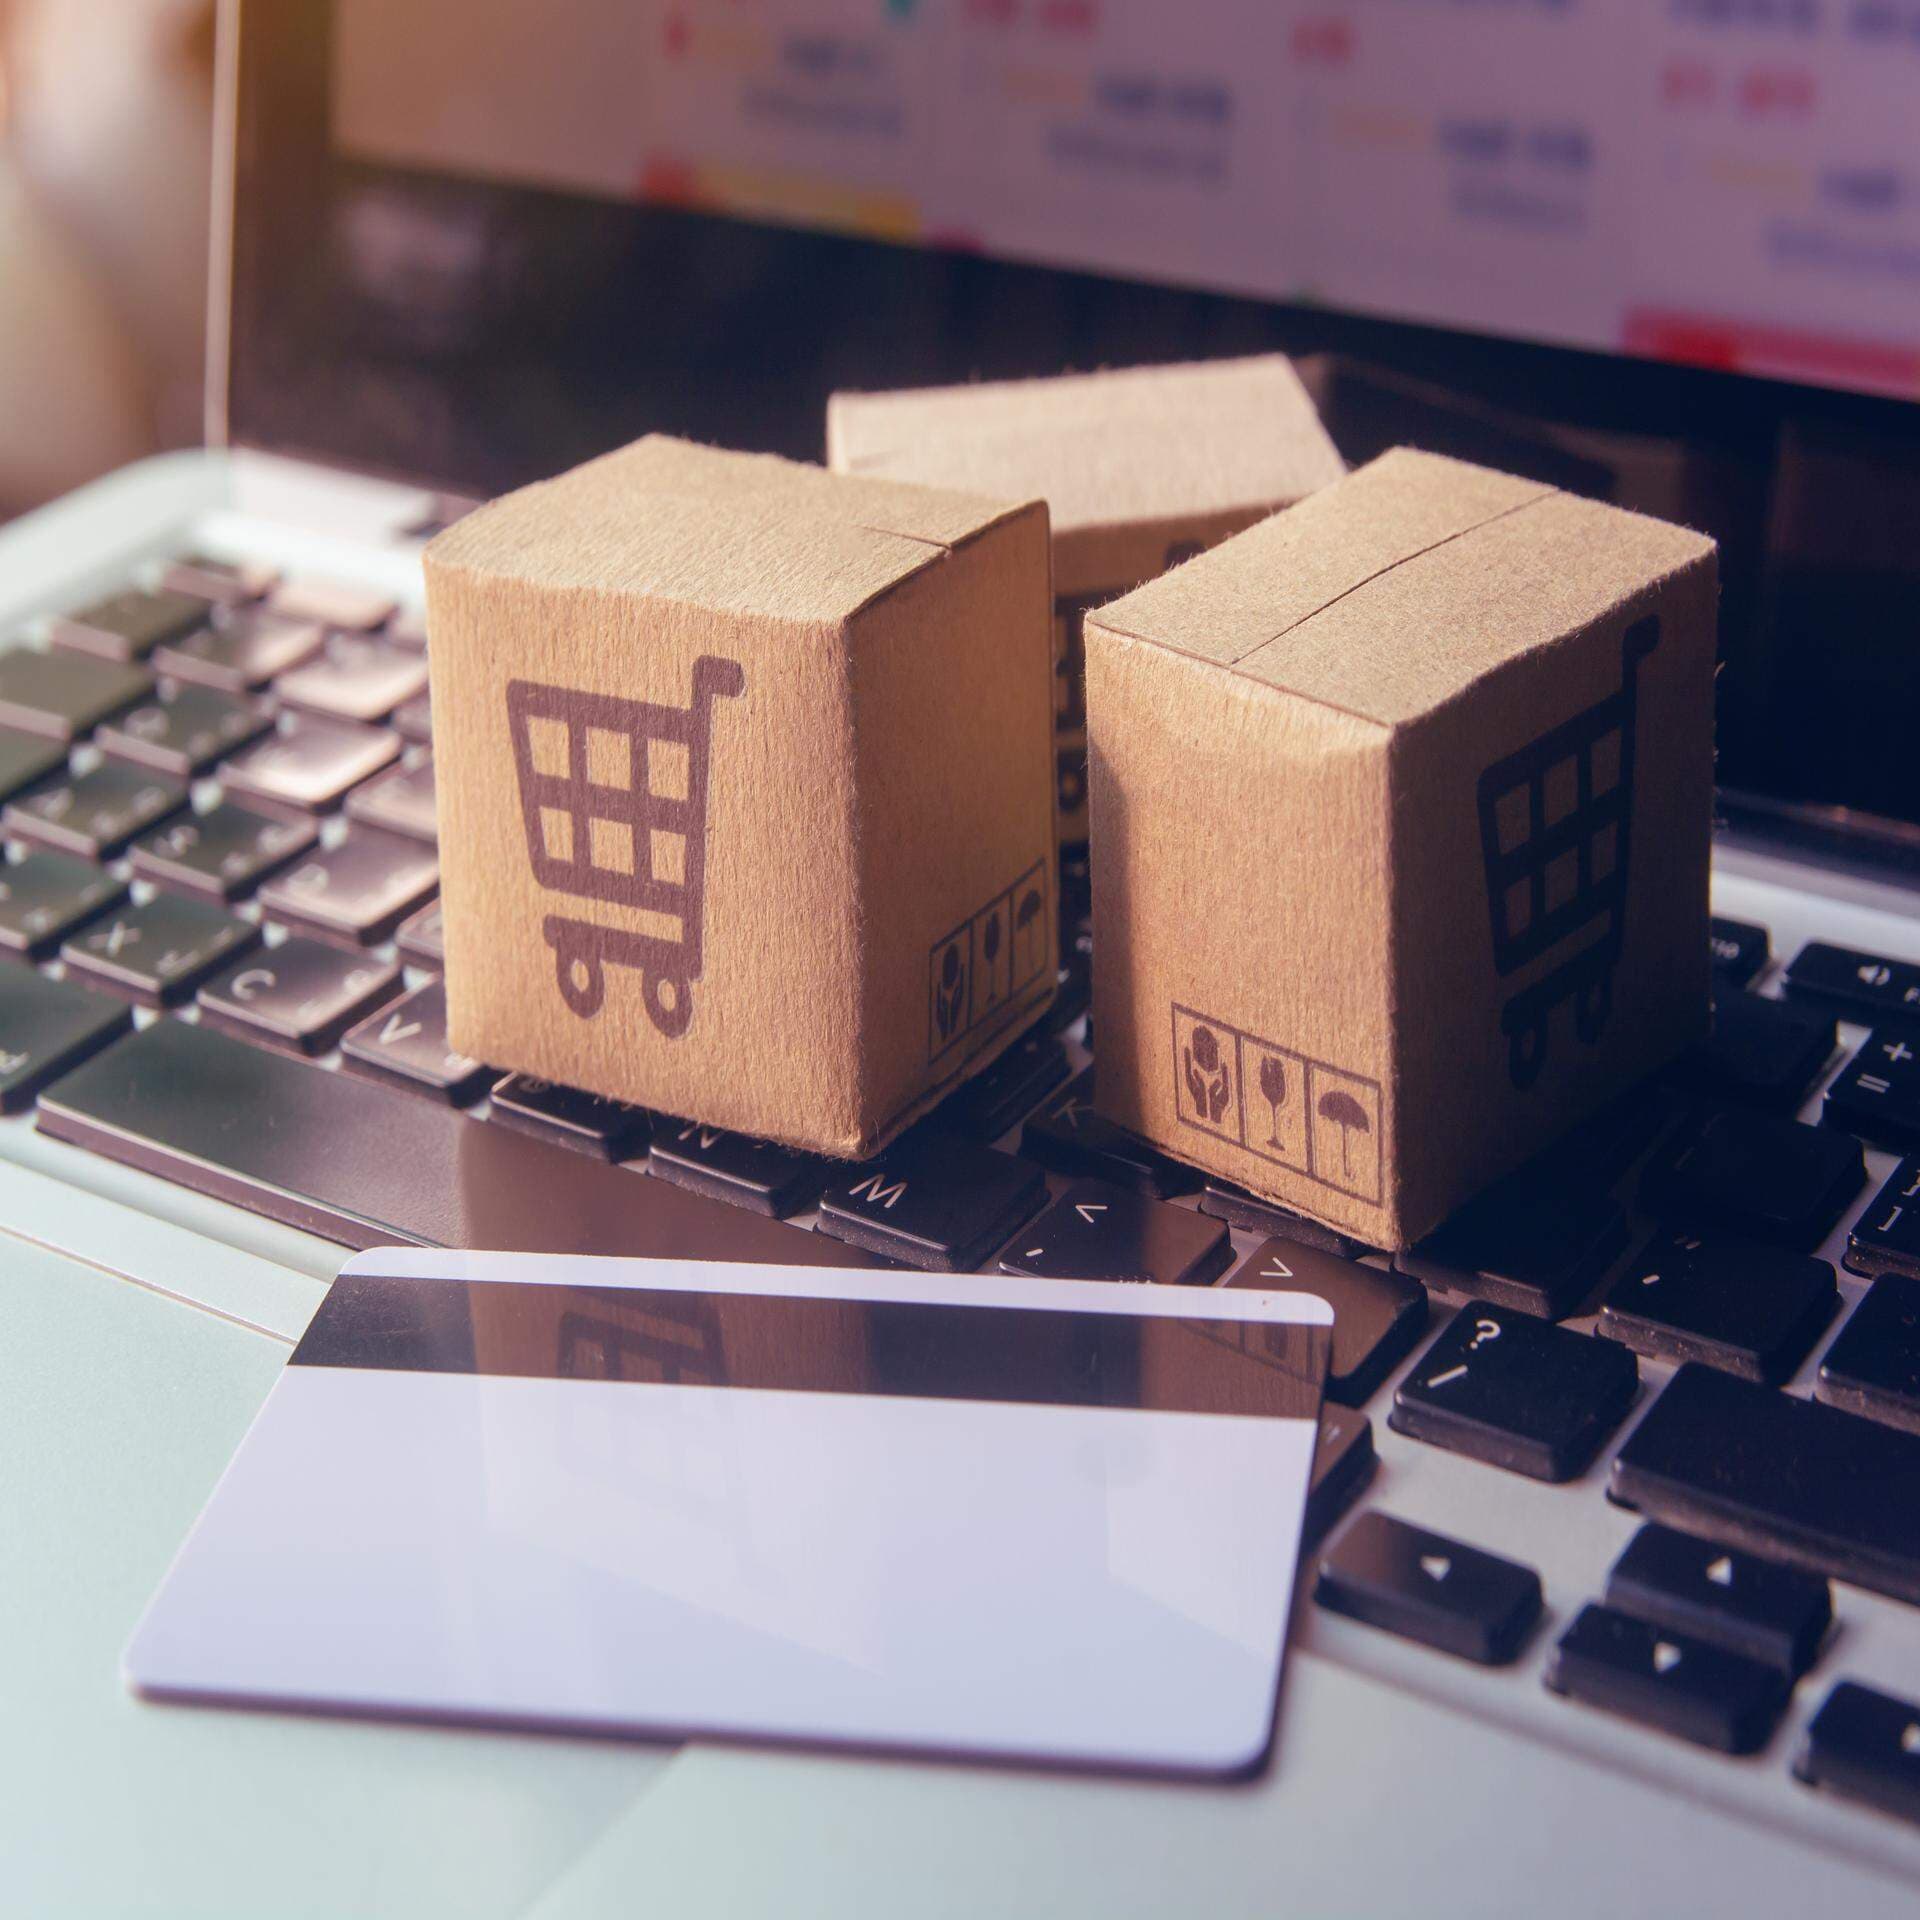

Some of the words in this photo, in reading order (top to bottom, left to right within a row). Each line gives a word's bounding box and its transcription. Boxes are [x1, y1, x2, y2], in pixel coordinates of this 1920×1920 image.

[86, 918, 142, 957] X
[231, 968, 277, 1000] C
[378, 1013, 423, 1045] V
[1881, 1042, 1913, 1062] +
[1857, 1073, 1891, 1094] =
[848, 1173, 908, 1209] M
[1075, 1204, 1108, 1223] <
[1877, 1205, 1904, 1233] ]
[1260, 1256, 1294, 1276] >
[1470, 1319, 1502, 1350] ?
[1427, 1364, 1469, 1389] /
